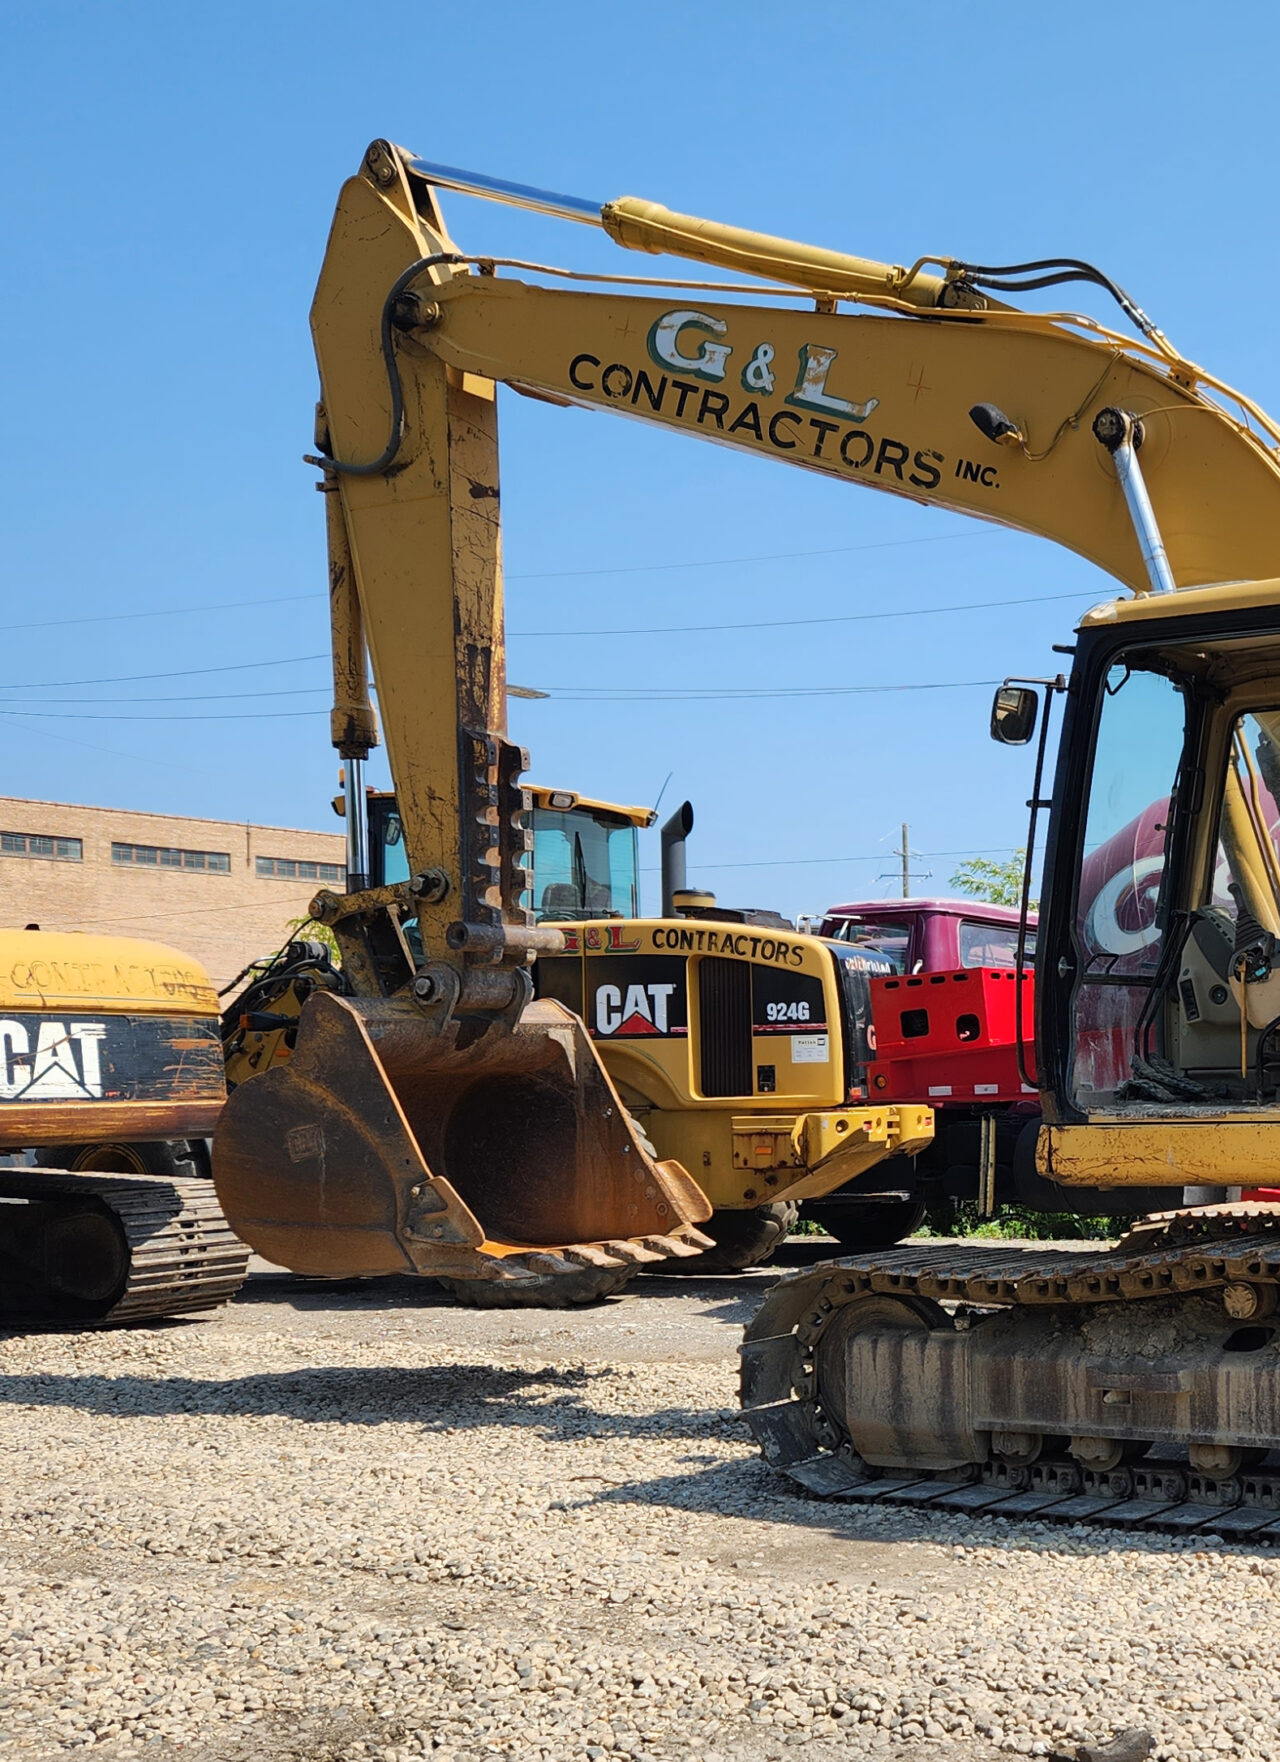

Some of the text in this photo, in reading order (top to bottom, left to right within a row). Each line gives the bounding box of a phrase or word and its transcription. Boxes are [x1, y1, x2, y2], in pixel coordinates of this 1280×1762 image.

[647, 308, 880, 423] G & L
[569, 354, 1001, 489] CONTRACTORS INC.
[587, 927, 602, 949] &
[605, 924, 642, 953] L
[652, 928, 805, 966] CONTRACTORS
[596, 984, 674, 1034] CAT
[766, 1001, 810, 1022] 924G
[0, 1019, 106, 1098] CAT
